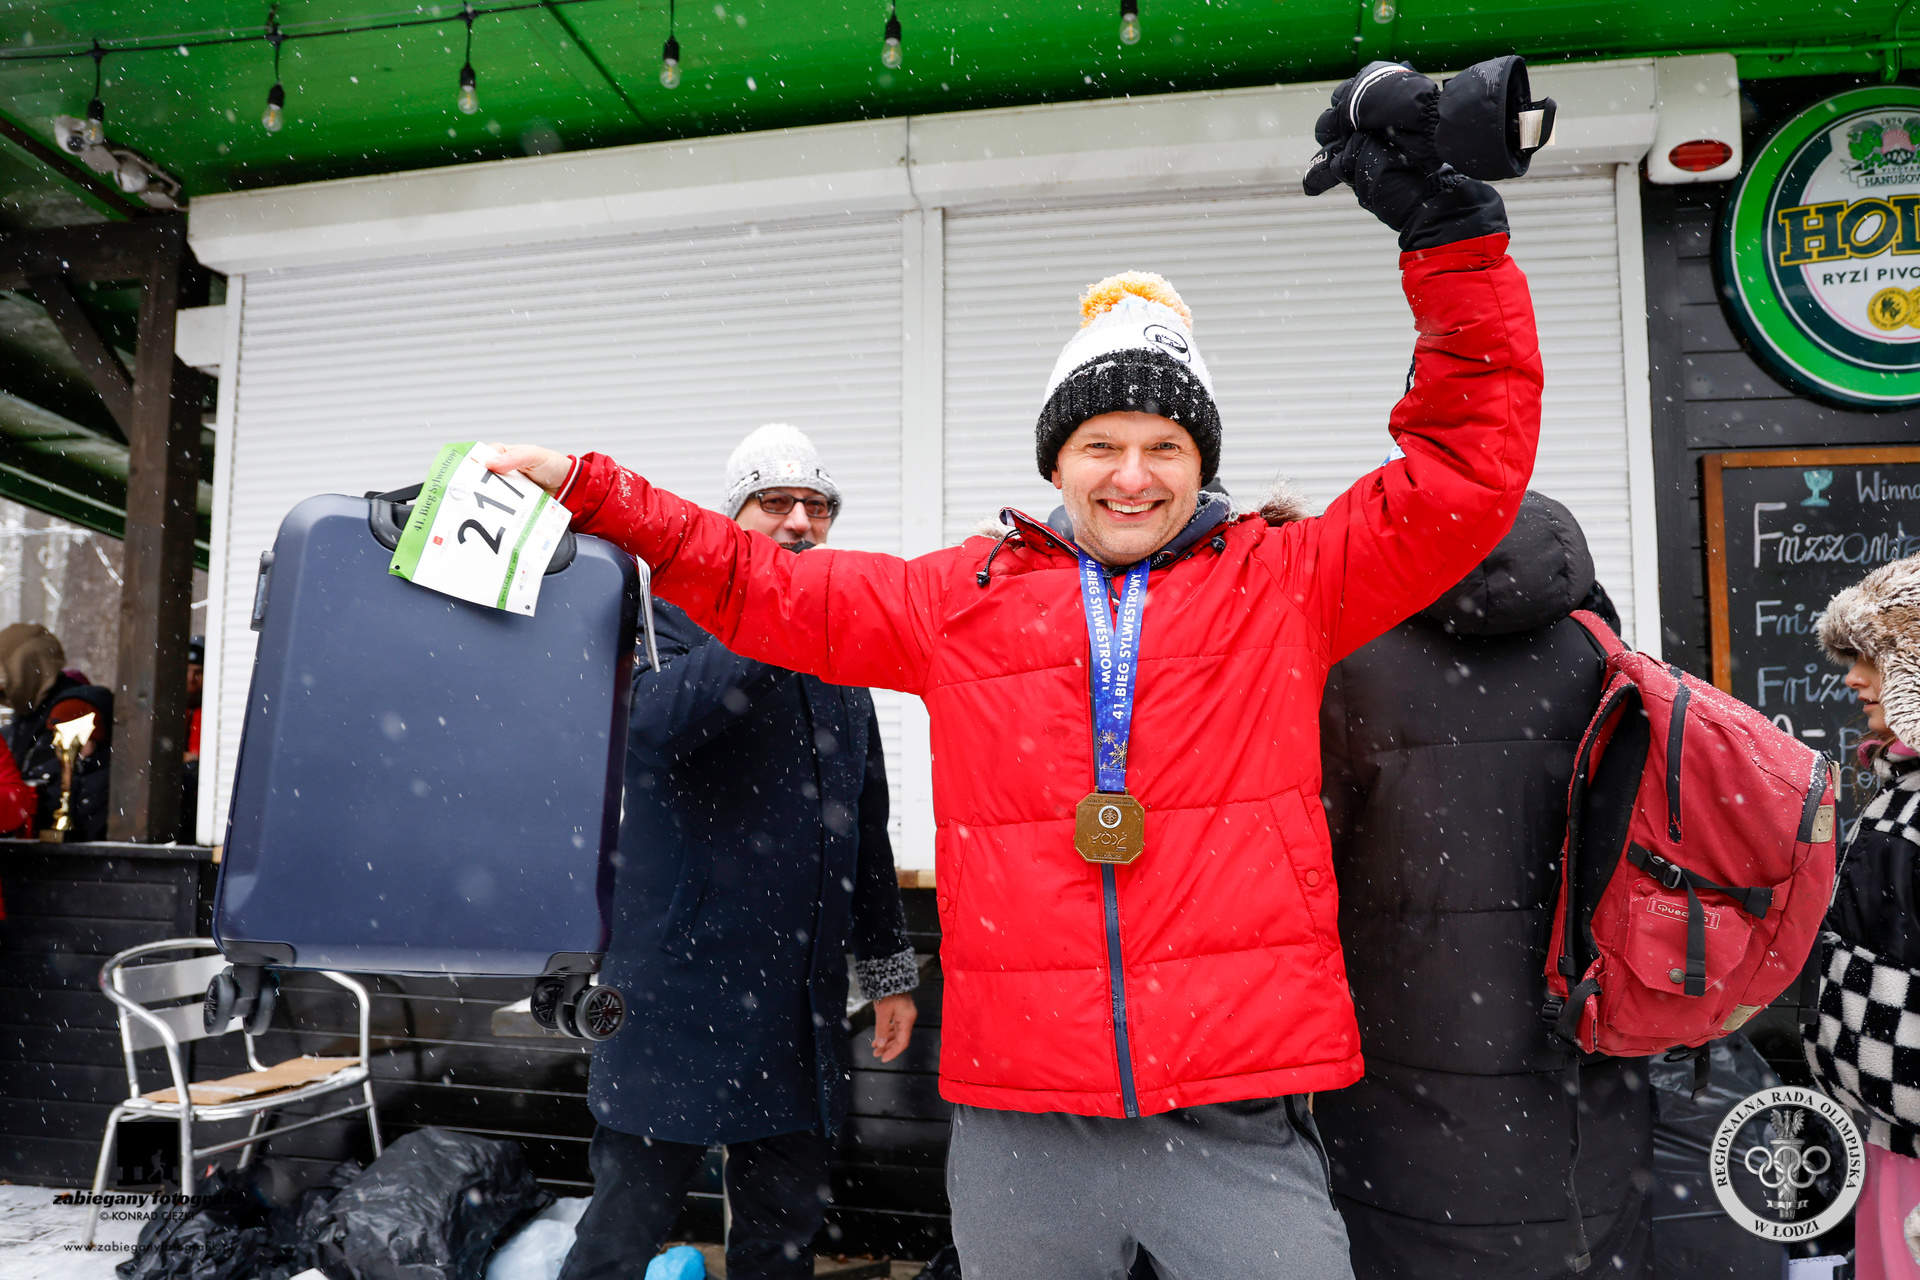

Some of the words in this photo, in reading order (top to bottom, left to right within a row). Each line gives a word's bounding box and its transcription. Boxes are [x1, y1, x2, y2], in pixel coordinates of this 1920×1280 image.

[1823, 267, 1868, 285] RYZÍ
[457, 469, 525, 555] 217
[1120, 574, 1142, 658] SYLWESTROWY
